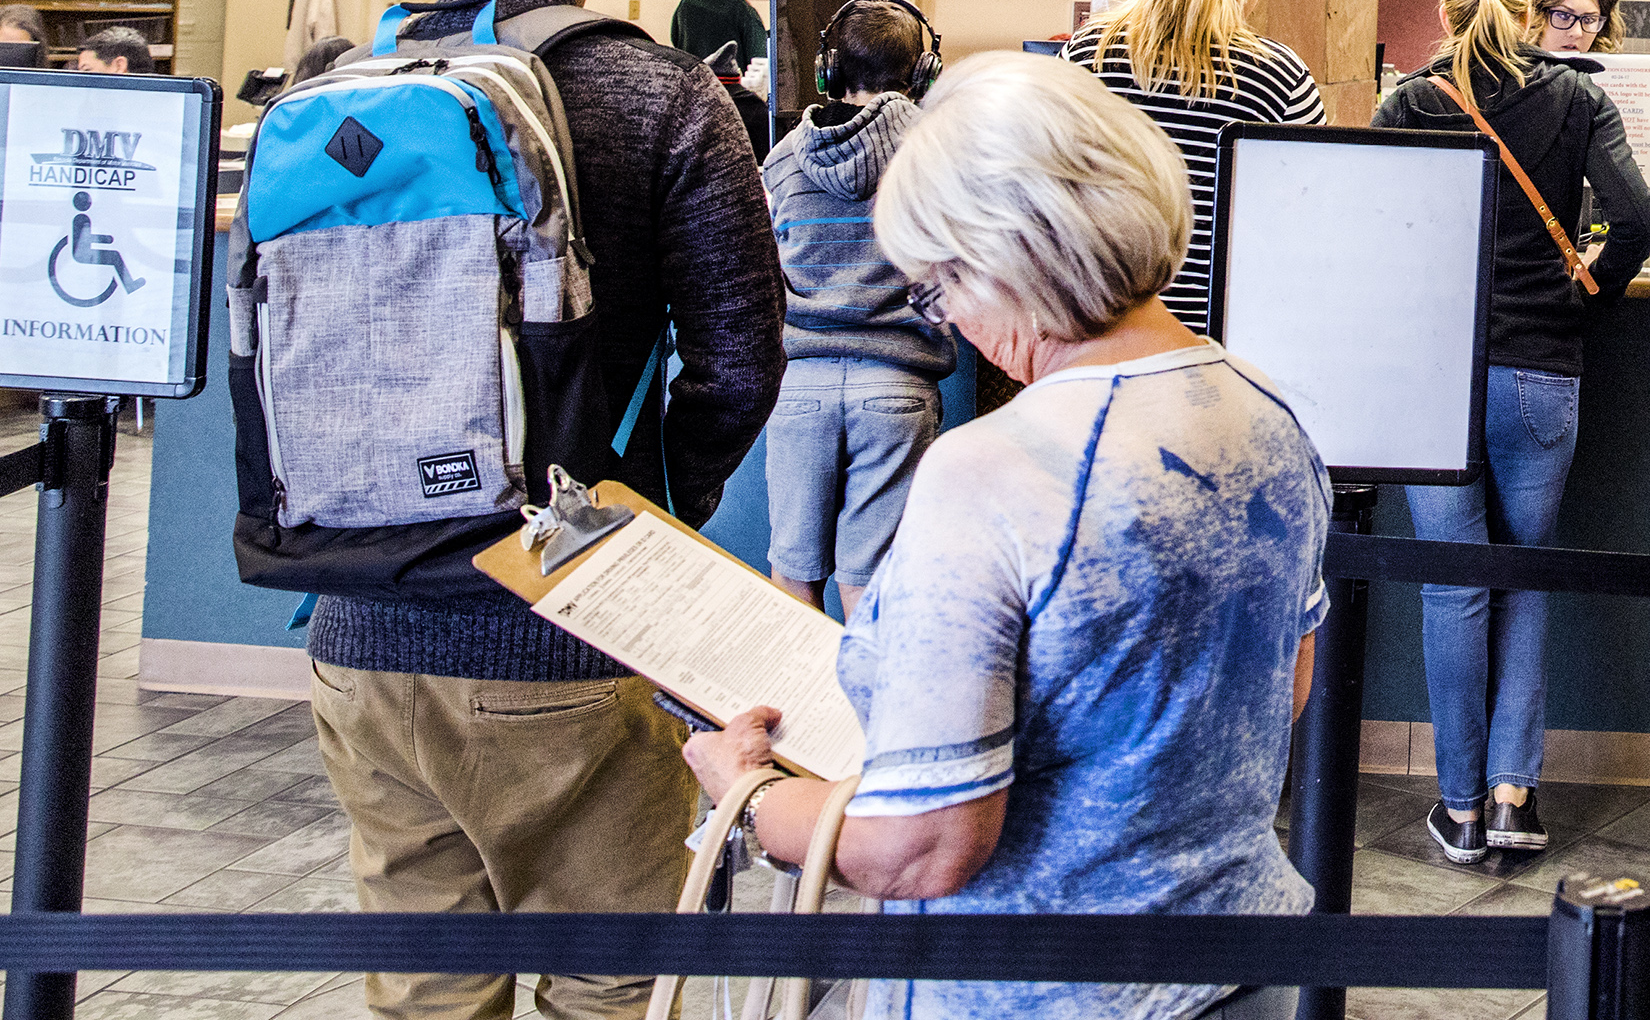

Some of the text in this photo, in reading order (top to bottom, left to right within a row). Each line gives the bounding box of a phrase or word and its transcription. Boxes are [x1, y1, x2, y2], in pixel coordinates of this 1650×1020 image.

[61, 127, 142, 161] DMV
[29, 165, 136, 187] HANDICAP
[3, 318, 167, 346] INFORMATION
[436, 461, 469, 475] BONDKA
